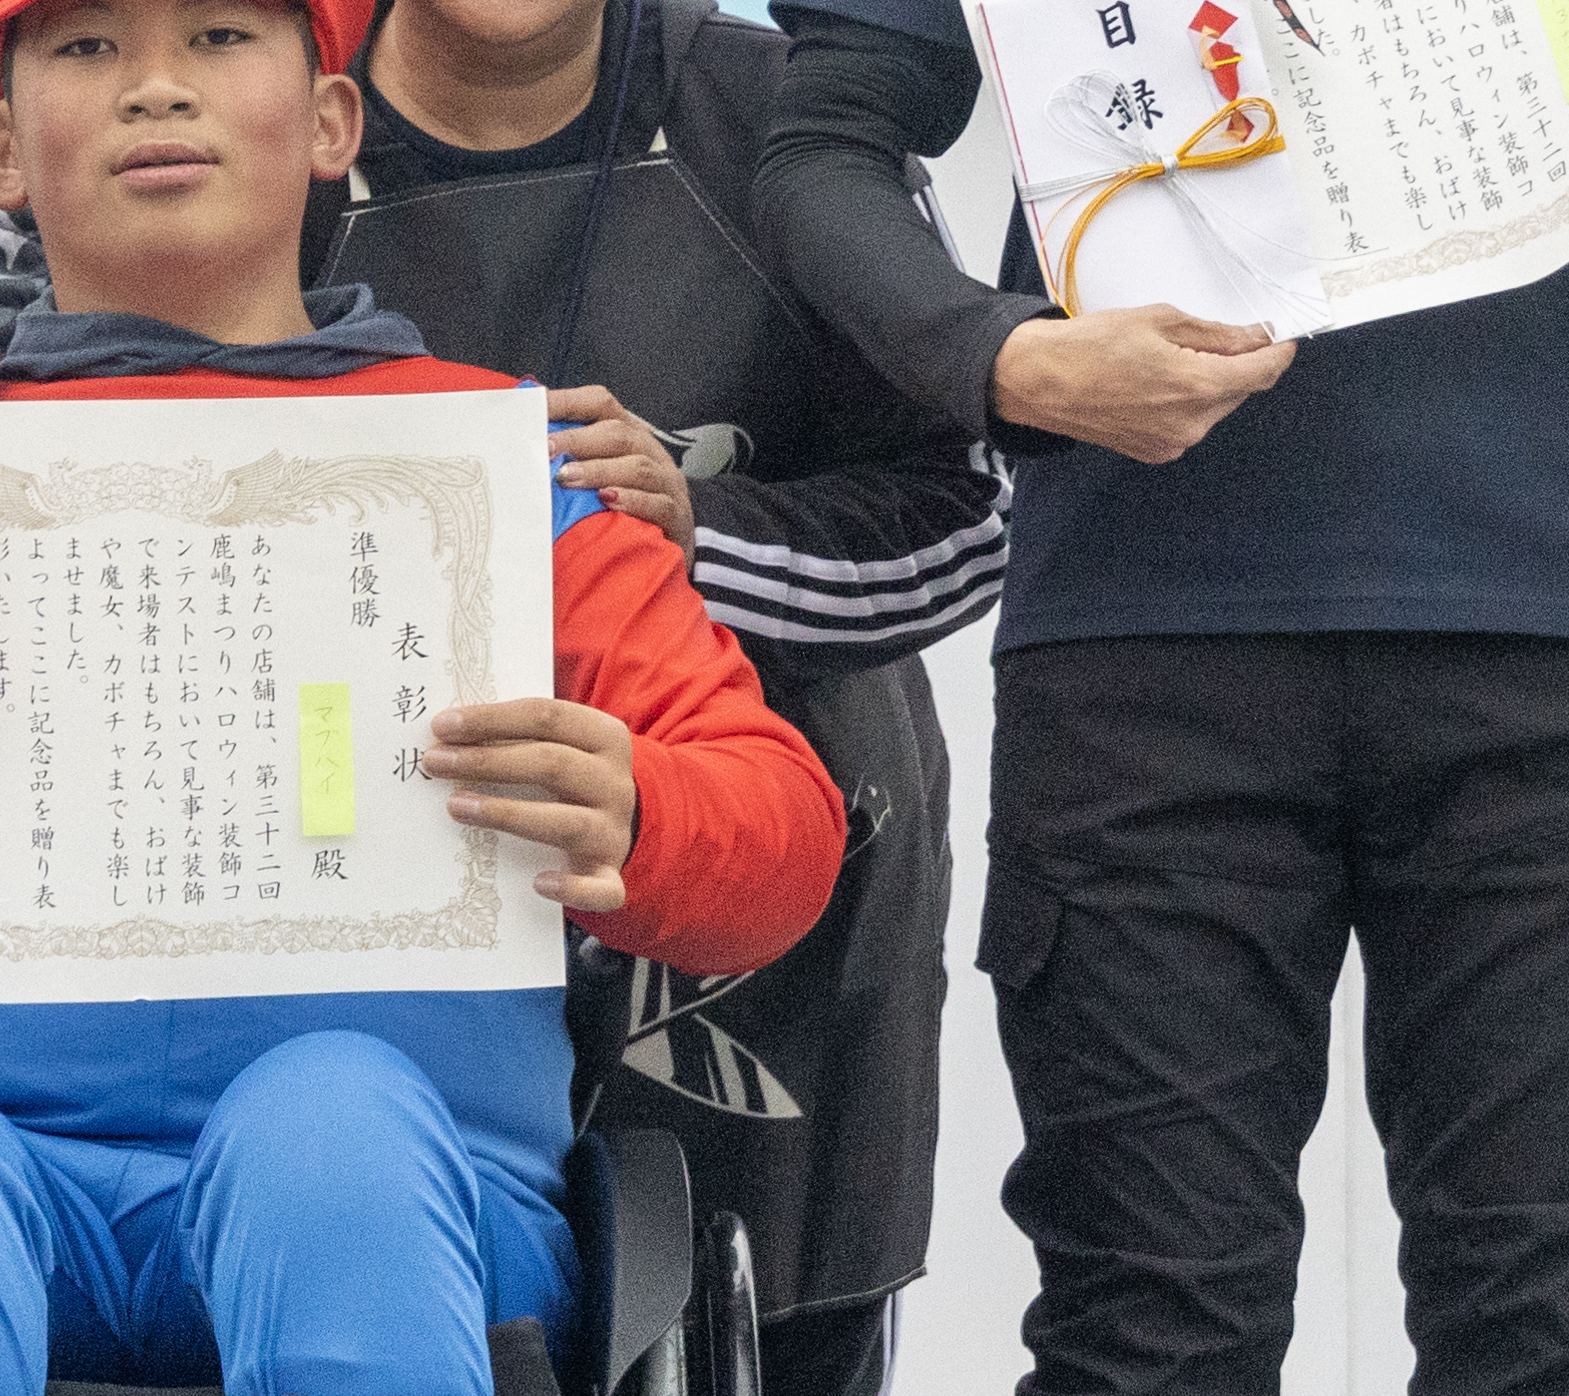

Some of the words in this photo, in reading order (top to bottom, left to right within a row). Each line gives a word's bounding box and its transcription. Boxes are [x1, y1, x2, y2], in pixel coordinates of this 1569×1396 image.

[1095, 0, 1164, 131] 目録
[349, 531, 382, 629] 準優勝
[391, 622, 433, 783] 表彰状
[311, 848, 349, 881] 殿
